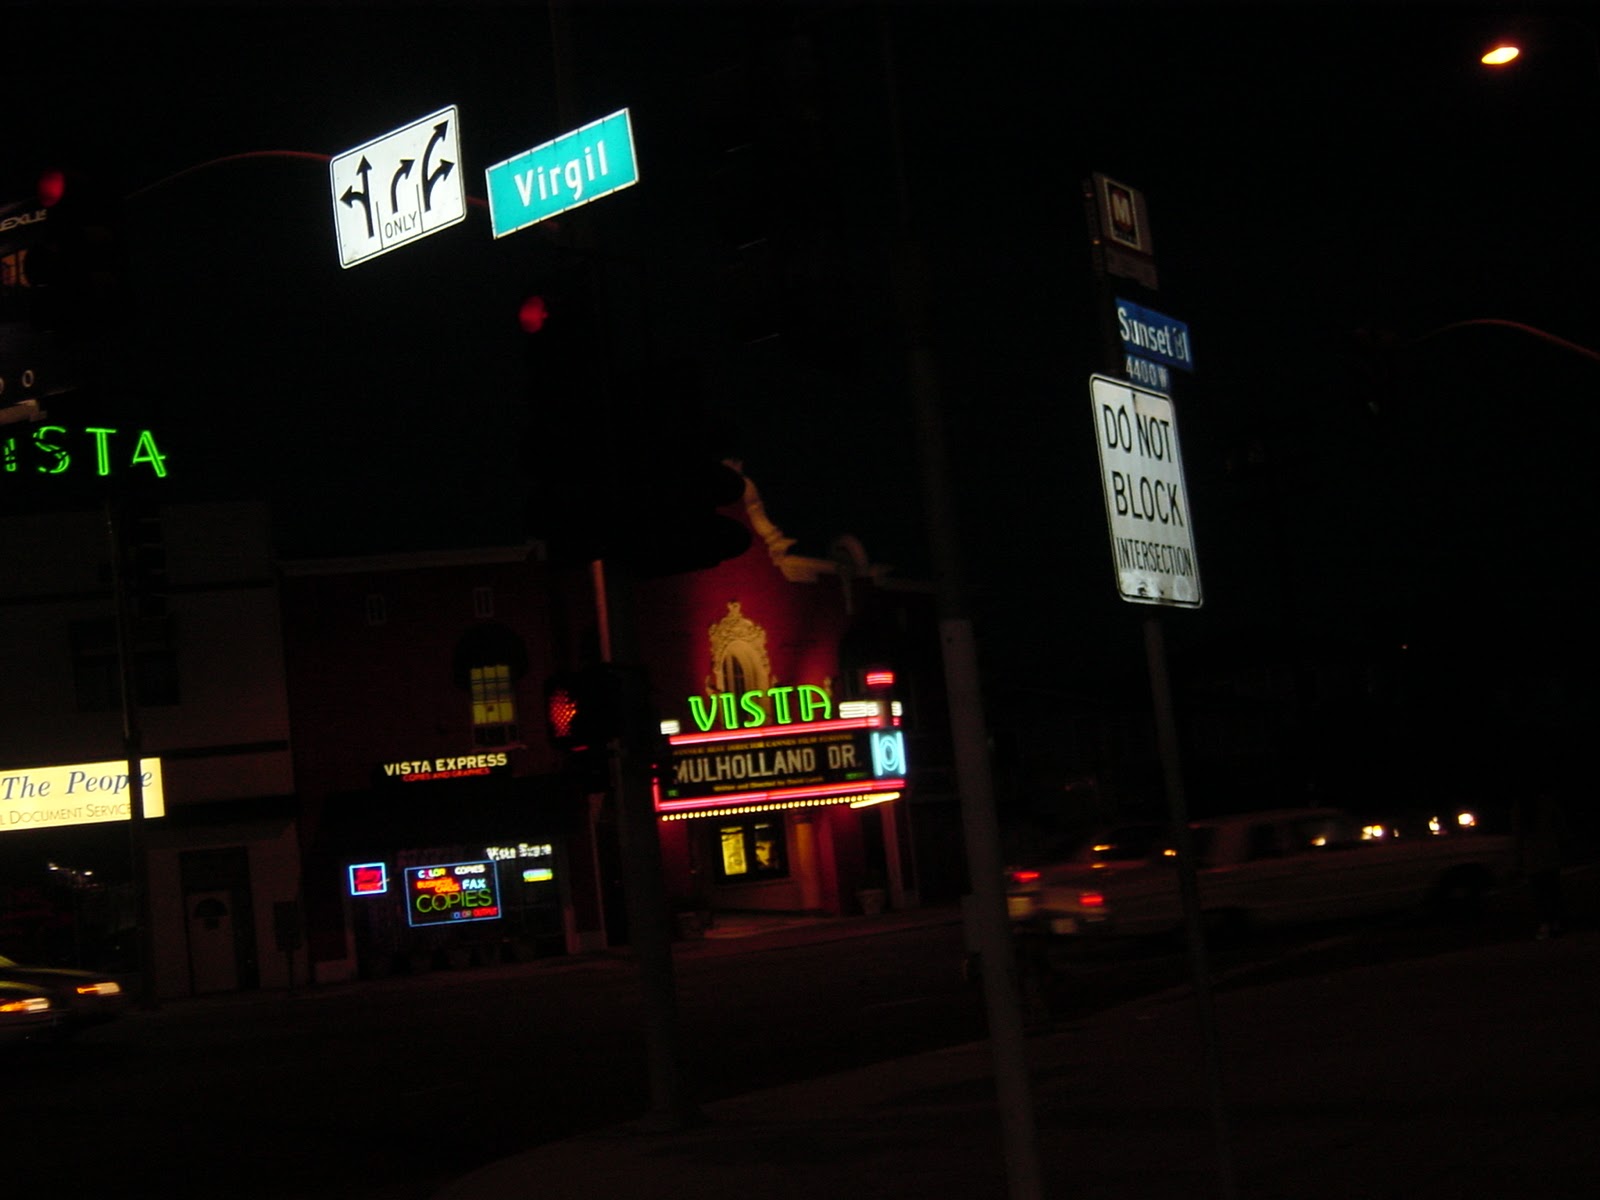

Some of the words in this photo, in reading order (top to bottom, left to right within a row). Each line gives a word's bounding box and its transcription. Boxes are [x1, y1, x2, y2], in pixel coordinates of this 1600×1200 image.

[514, 141, 608, 207] Virgil
[384, 211, 418, 240] ONLY
[1116, 306, 1173, 358] Sunset
[1103, 404, 1132, 453] DO
[1136, 413, 1172, 463] NOT
[1111, 470, 1184, 527] BLOCK
[1116, 537, 1193, 577] INTERSECTION
[688, 684, 832, 732] VISTA
[384, 760, 432, 776] VISTA
[435, 753, 508, 771] EXPRESS
[673, 747, 816, 784] MULHOLLAND
[1, 775, 51, 800] The
[65, 770, 153, 795] Peope
[416, 888, 492, 912] COPIES
[462, 878, 486, 890] FAX
